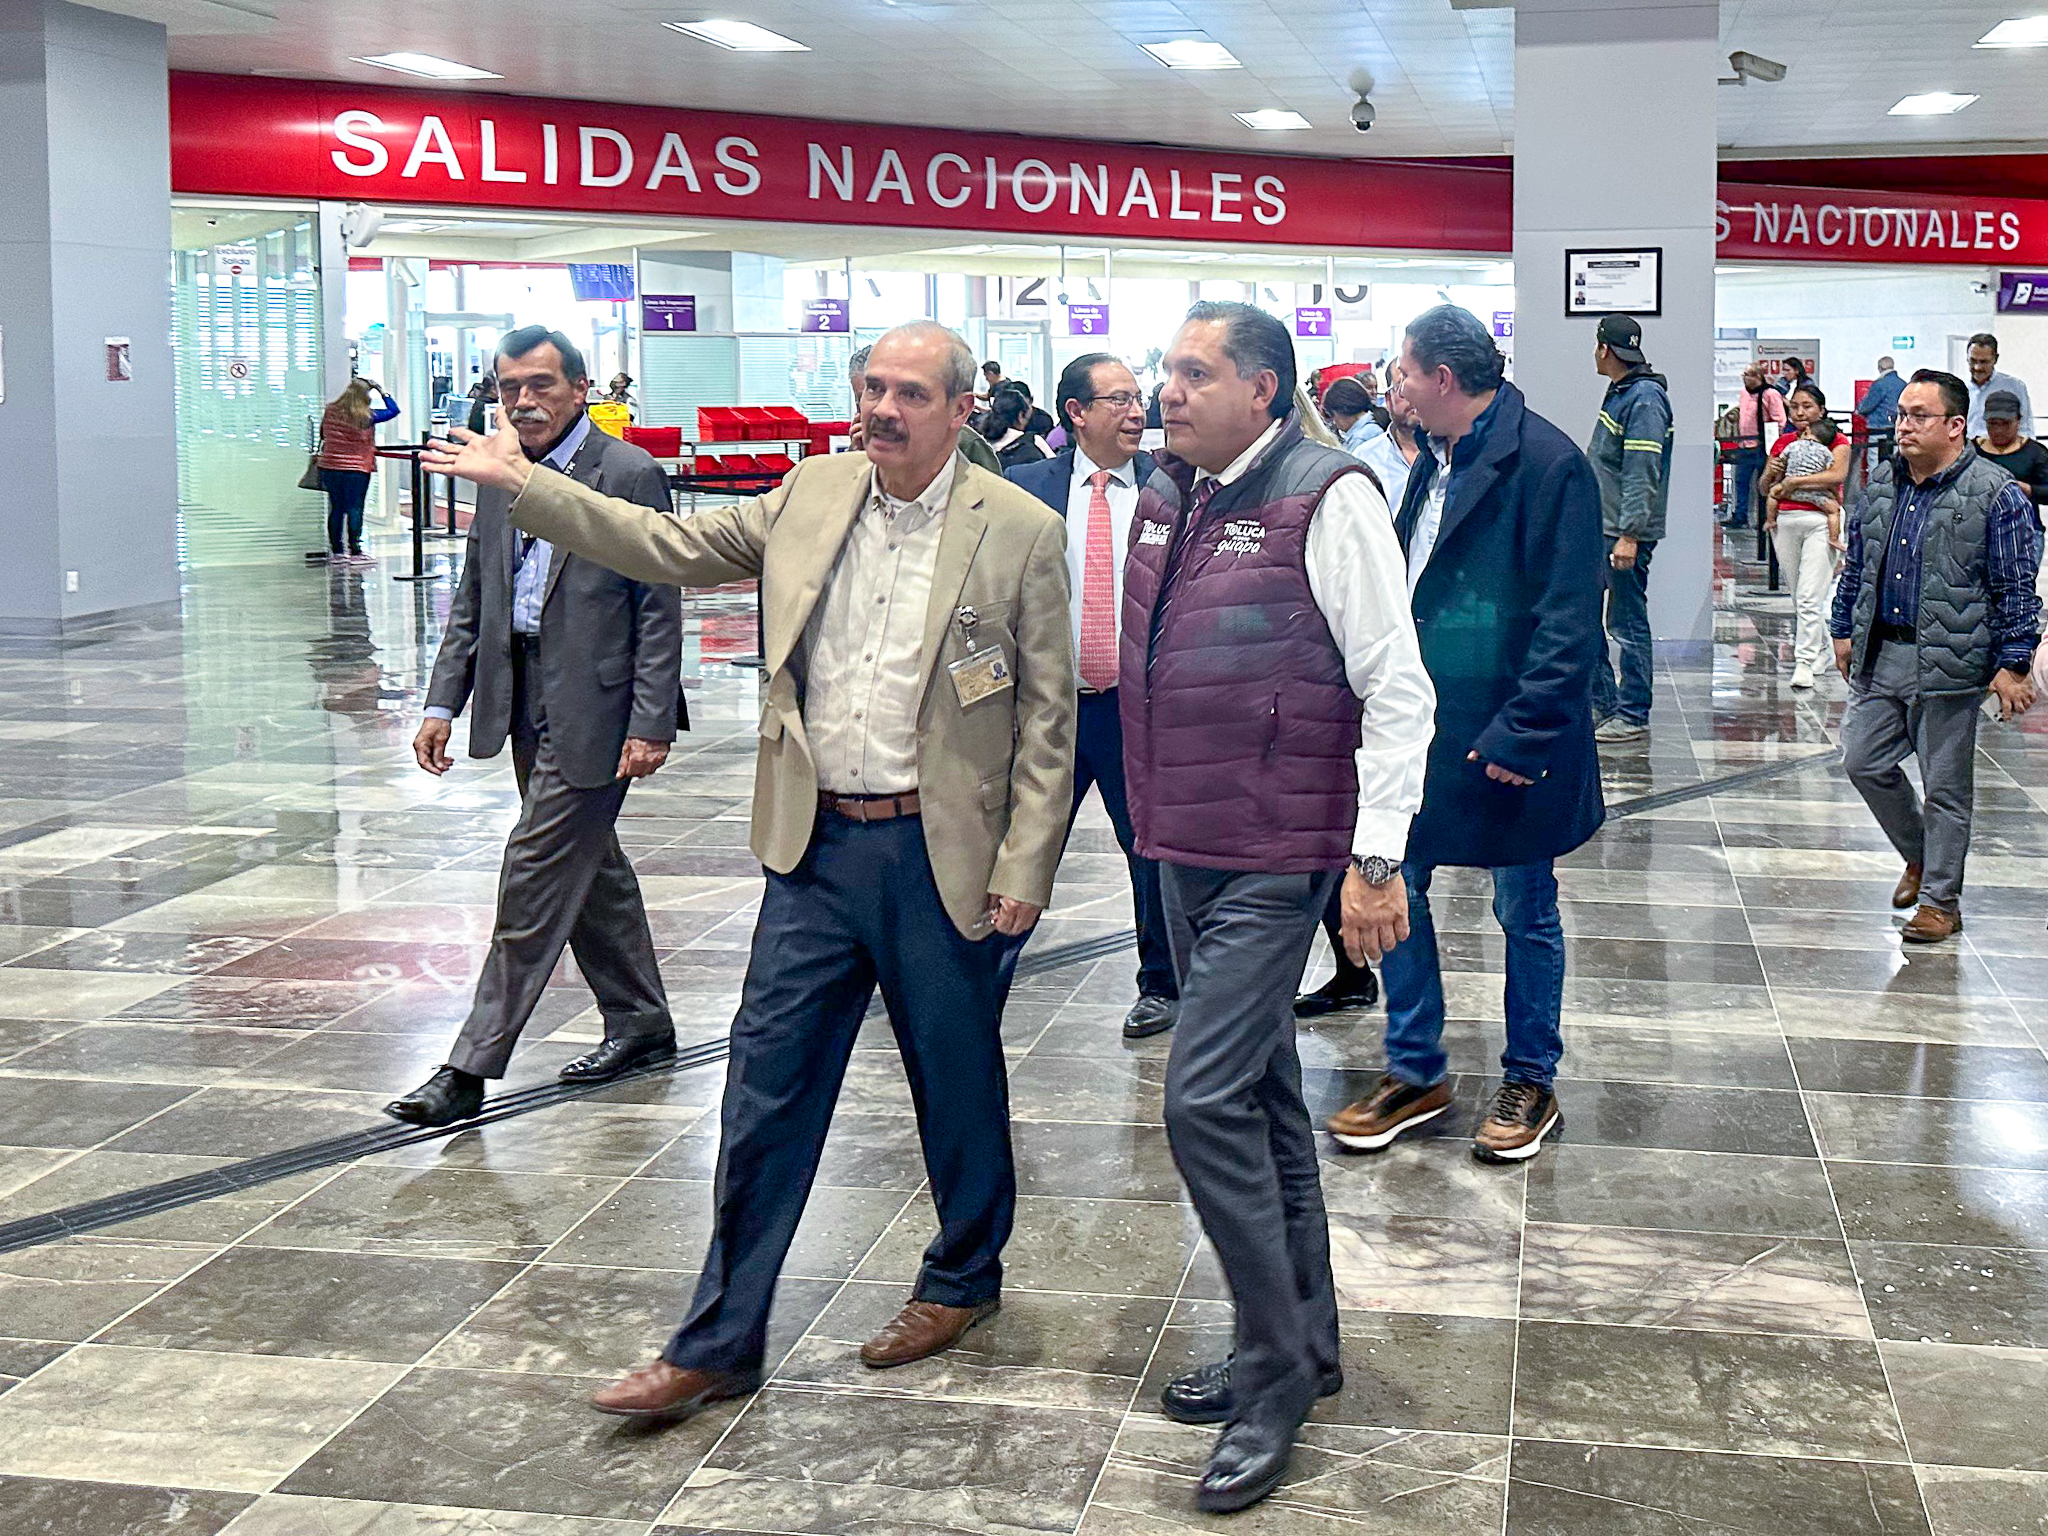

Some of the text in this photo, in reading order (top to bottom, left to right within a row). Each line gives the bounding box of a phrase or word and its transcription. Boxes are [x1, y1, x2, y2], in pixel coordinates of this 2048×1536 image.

[331, 110, 1287, 227] SALIDAS NACIONALES
[1754, 202, 2020, 251] NACIONALES
[664, 312, 674, 329] 1
[818, 315, 830, 331] 2
[1082, 319, 1093, 334] 3
[1308, 321, 1318, 335] 4
[1502, 322, 1512, 336] 5
[1142, 519, 1171, 535] TOLUC
[1223, 522, 1266, 539] TOLUCA
[1213, 539, 1262, 559] guapa
